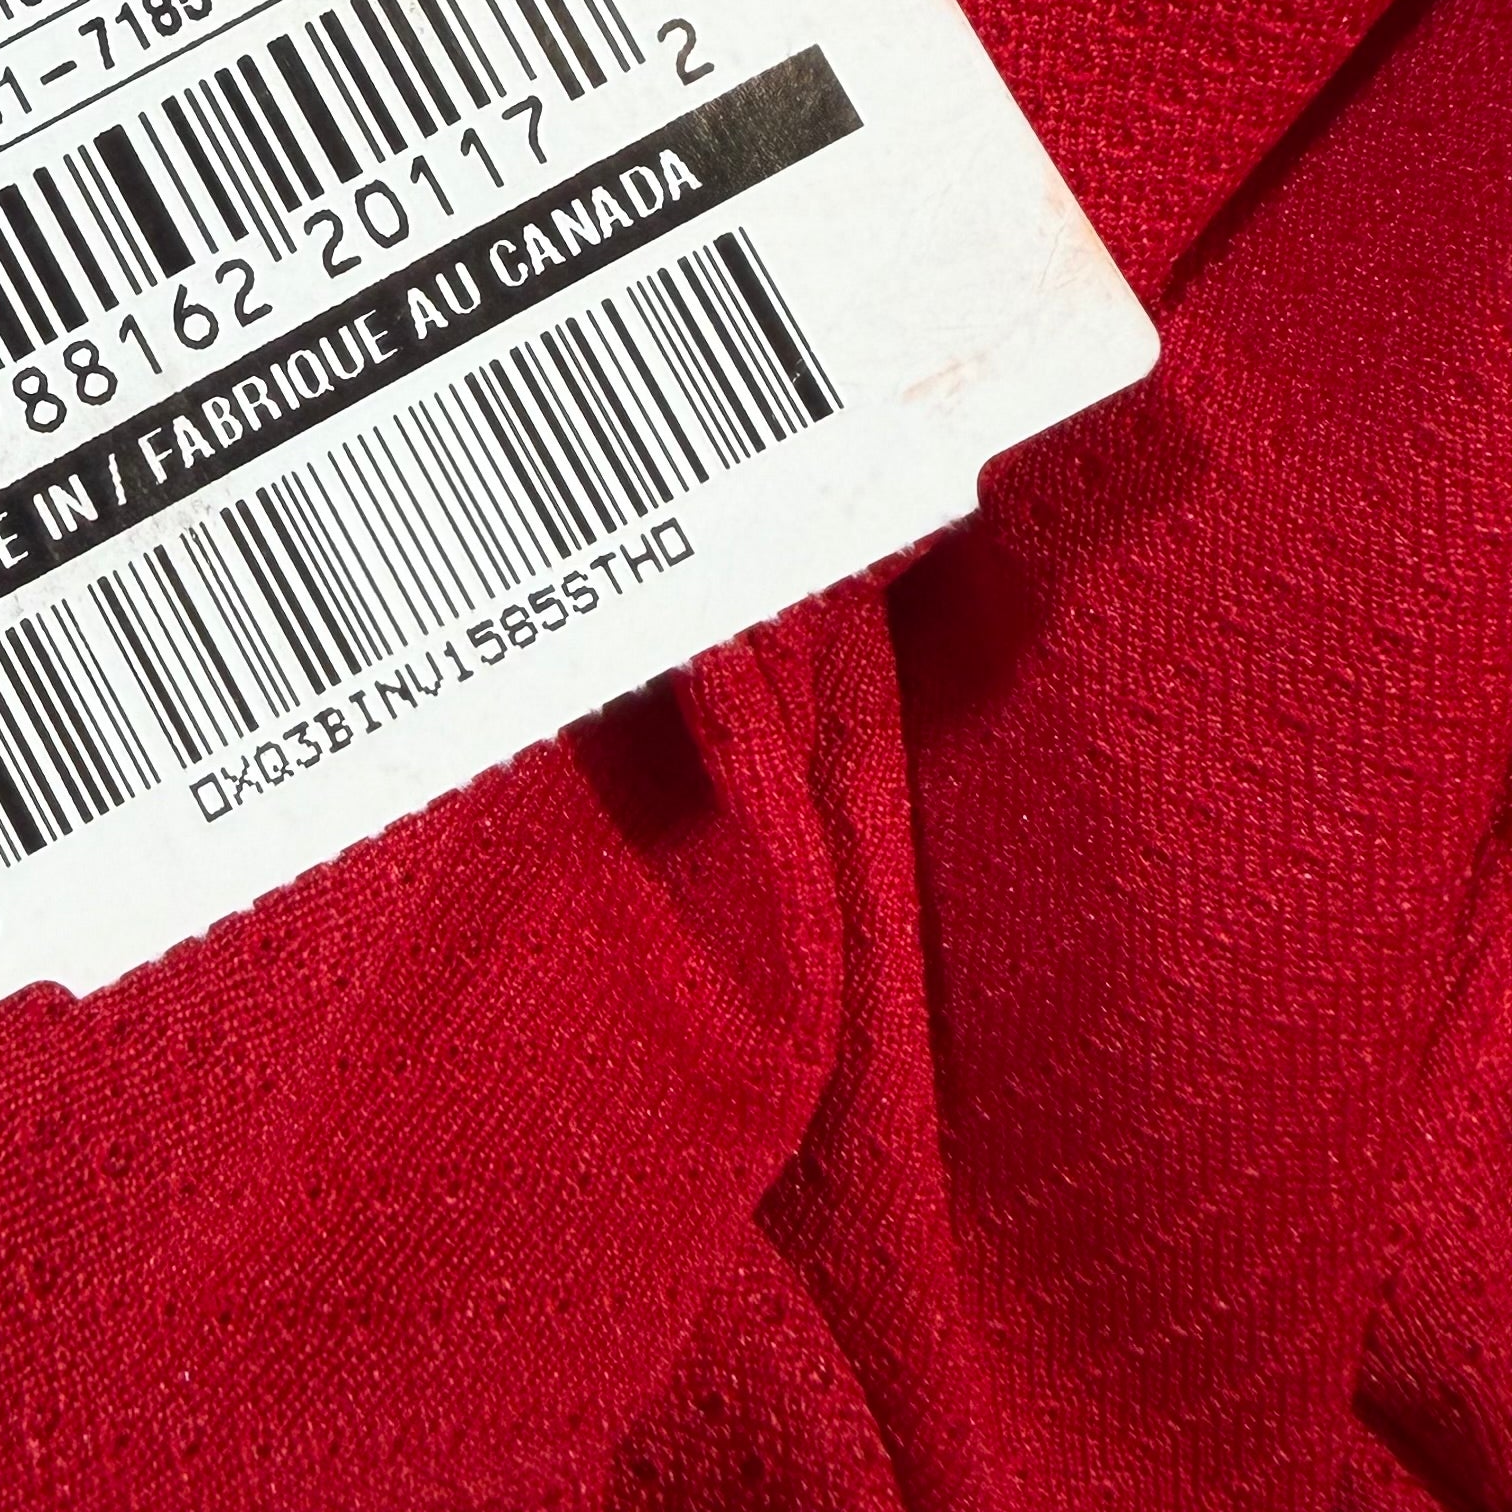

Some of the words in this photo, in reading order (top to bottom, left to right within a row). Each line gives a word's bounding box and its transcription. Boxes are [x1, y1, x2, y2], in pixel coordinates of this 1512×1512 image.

[12, 258, 272, 433] 88162
[304, 95, 547, 278] 20117
[657, 18, 714, 85] 2
[33, 474, 98, 540] IN
[108, 453, 126, 505] /
[138, 309, 398, 483] FABRIQUE
[407, 262, 481, 339] AU
[490, 149, 703, 286] CANADA
